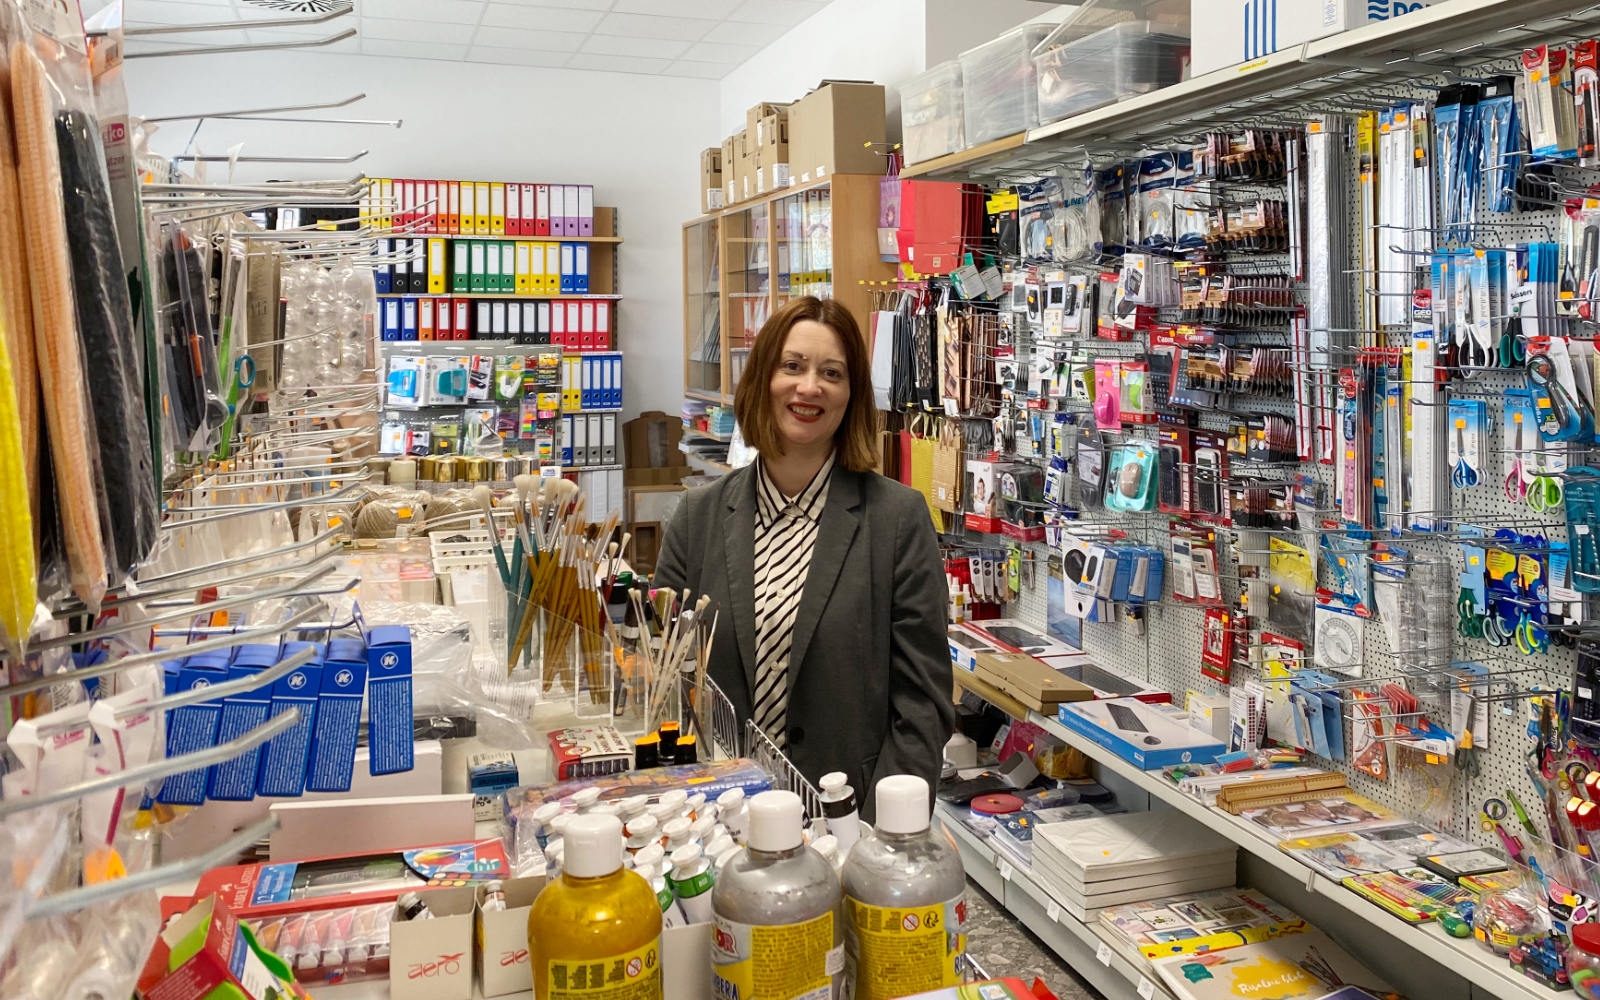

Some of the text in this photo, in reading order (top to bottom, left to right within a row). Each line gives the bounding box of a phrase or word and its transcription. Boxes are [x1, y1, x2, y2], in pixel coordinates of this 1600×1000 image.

[1510, 289, 1533, 300] Scissors
[1157, 335, 1174, 343] Canon
[1185, 333, 1204, 342] Canon
[408, 952, 465, 979] aero
